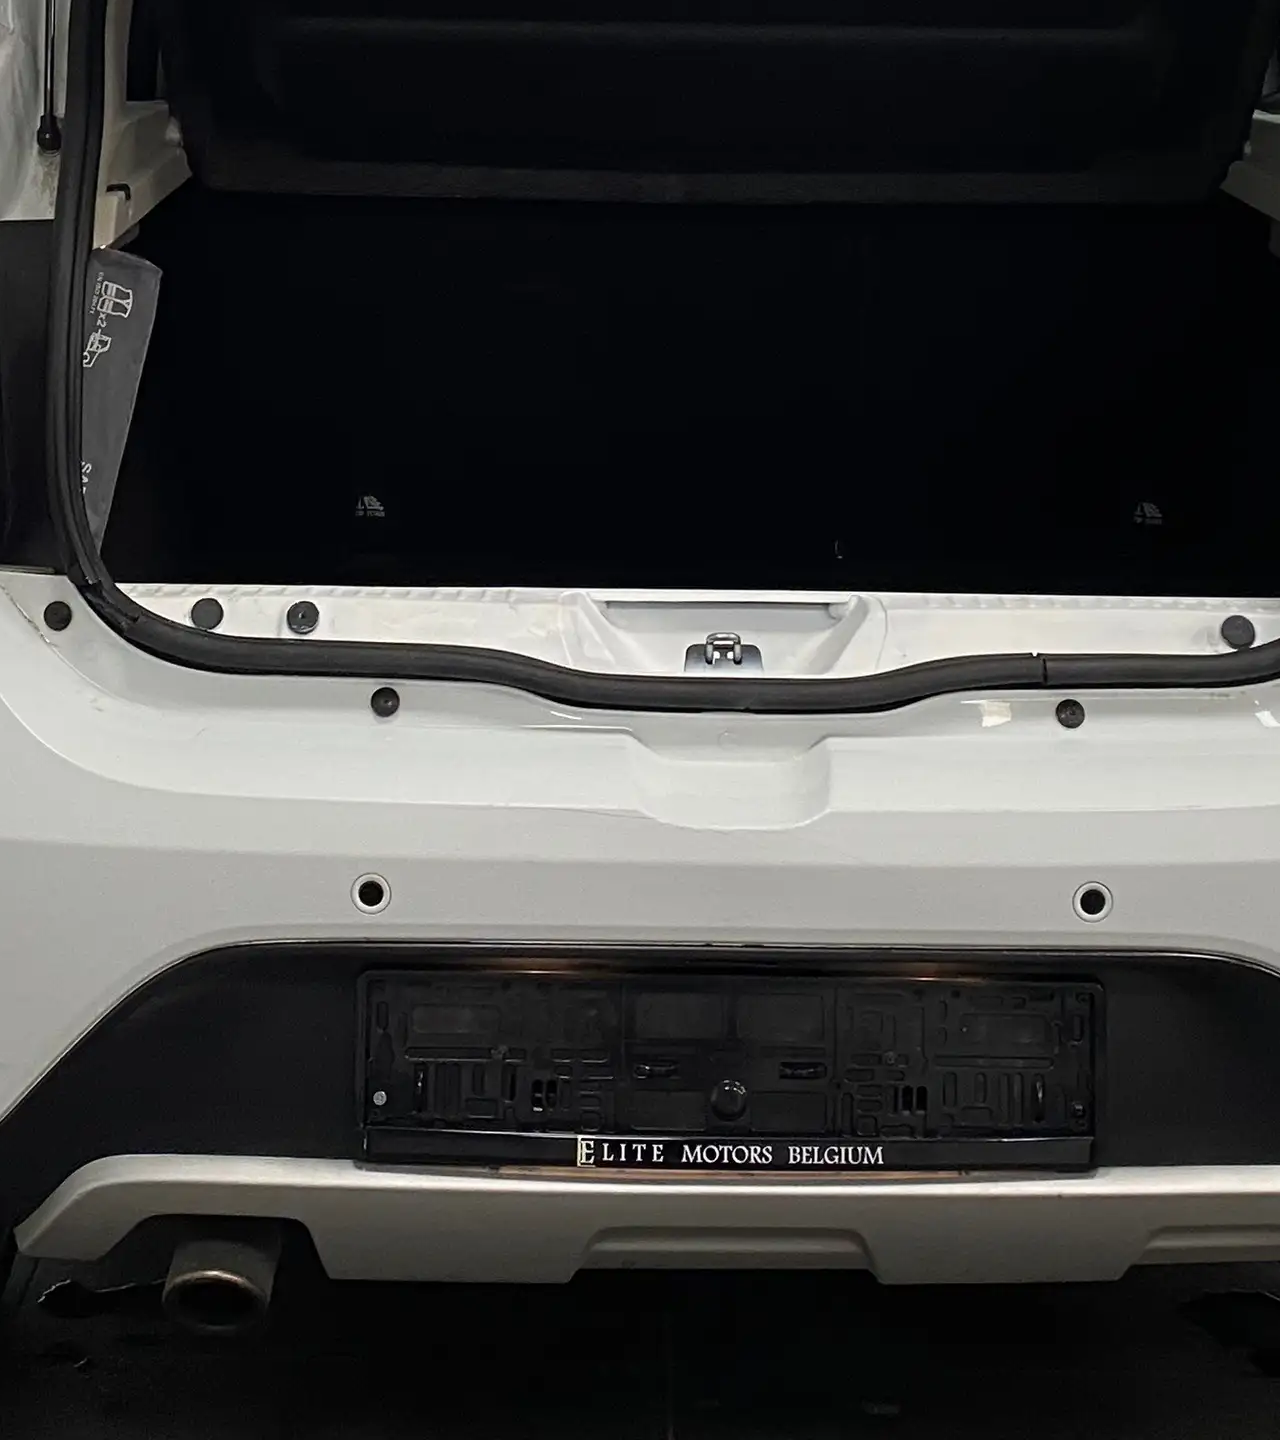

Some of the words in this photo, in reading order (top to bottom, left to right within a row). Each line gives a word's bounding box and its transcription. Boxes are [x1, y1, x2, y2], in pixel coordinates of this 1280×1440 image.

[577, 1135, 664, 1167] ELITE
[681, 1144, 773, 1165] MOTORS
[787, 1145, 885, 1166] BELGIUM
